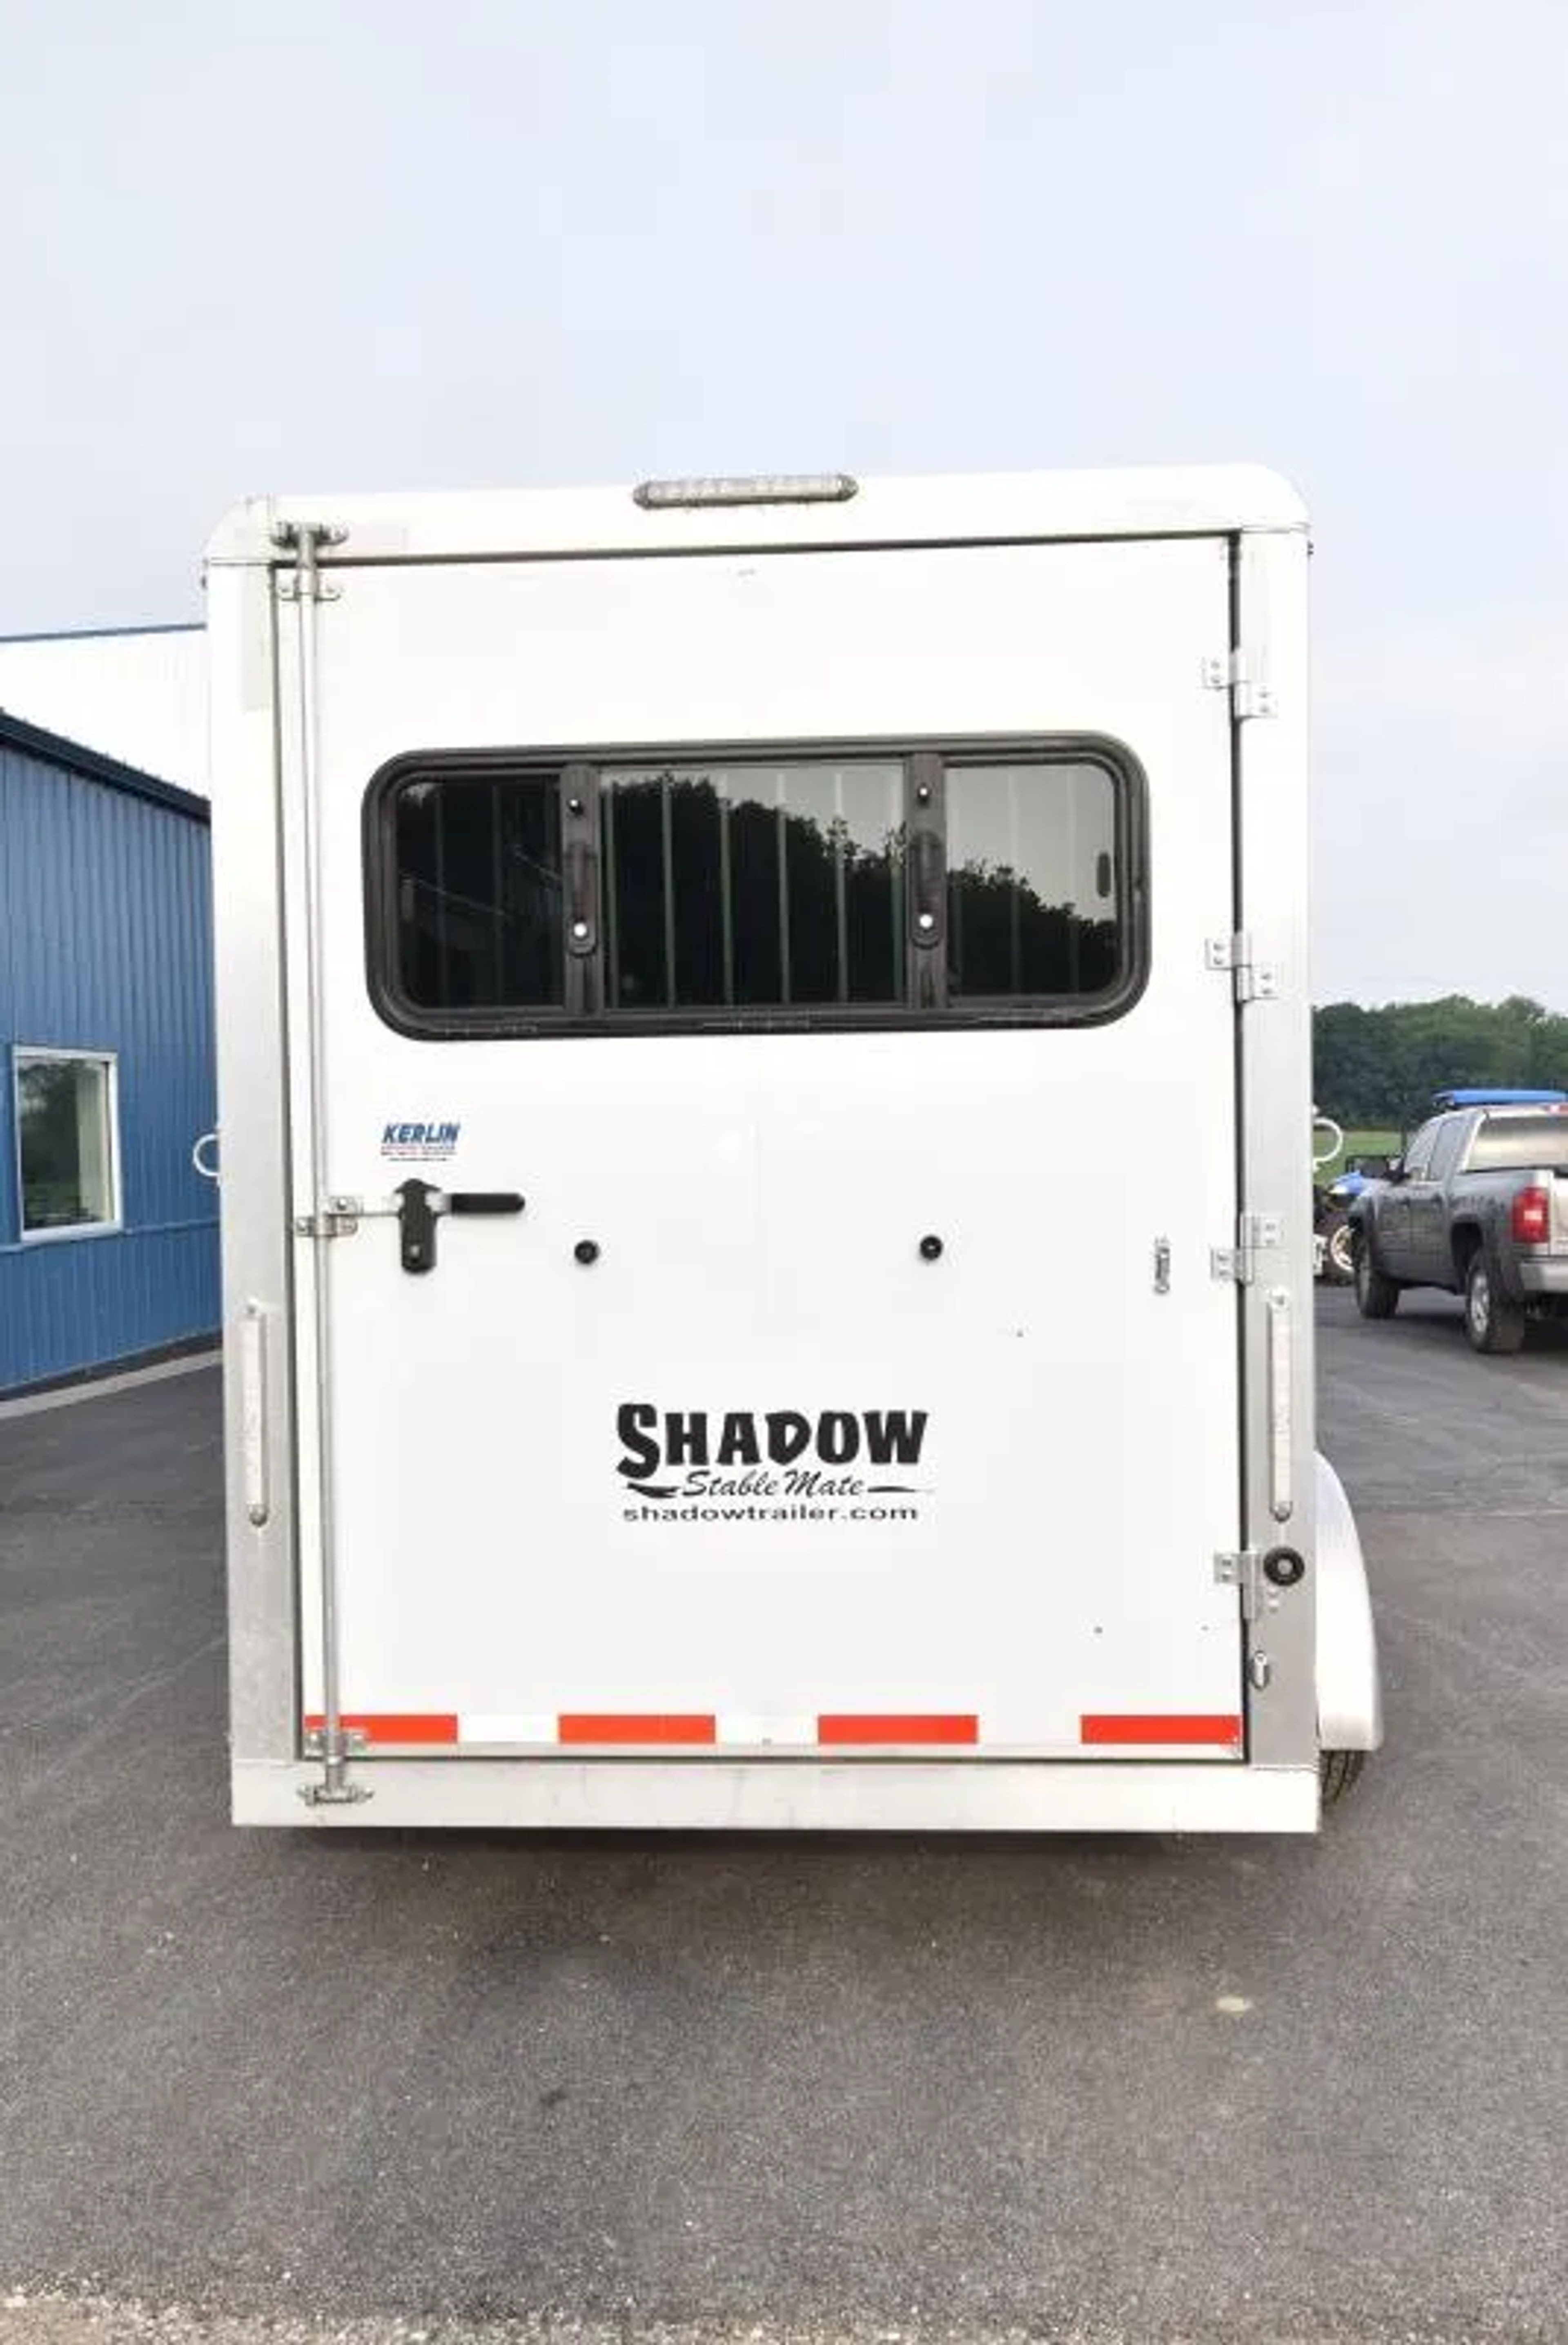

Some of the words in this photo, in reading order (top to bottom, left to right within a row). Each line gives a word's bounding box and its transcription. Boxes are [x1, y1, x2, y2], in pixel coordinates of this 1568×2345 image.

[382, 1122, 460, 1144] KERLIN
[616, 1403, 929, 1480] SHADOW
[682, 1470, 778, 1497] Stable
[784, 1470, 864, 1498] Mate
[623, 1504, 918, 1522] shadowtrailer.com
